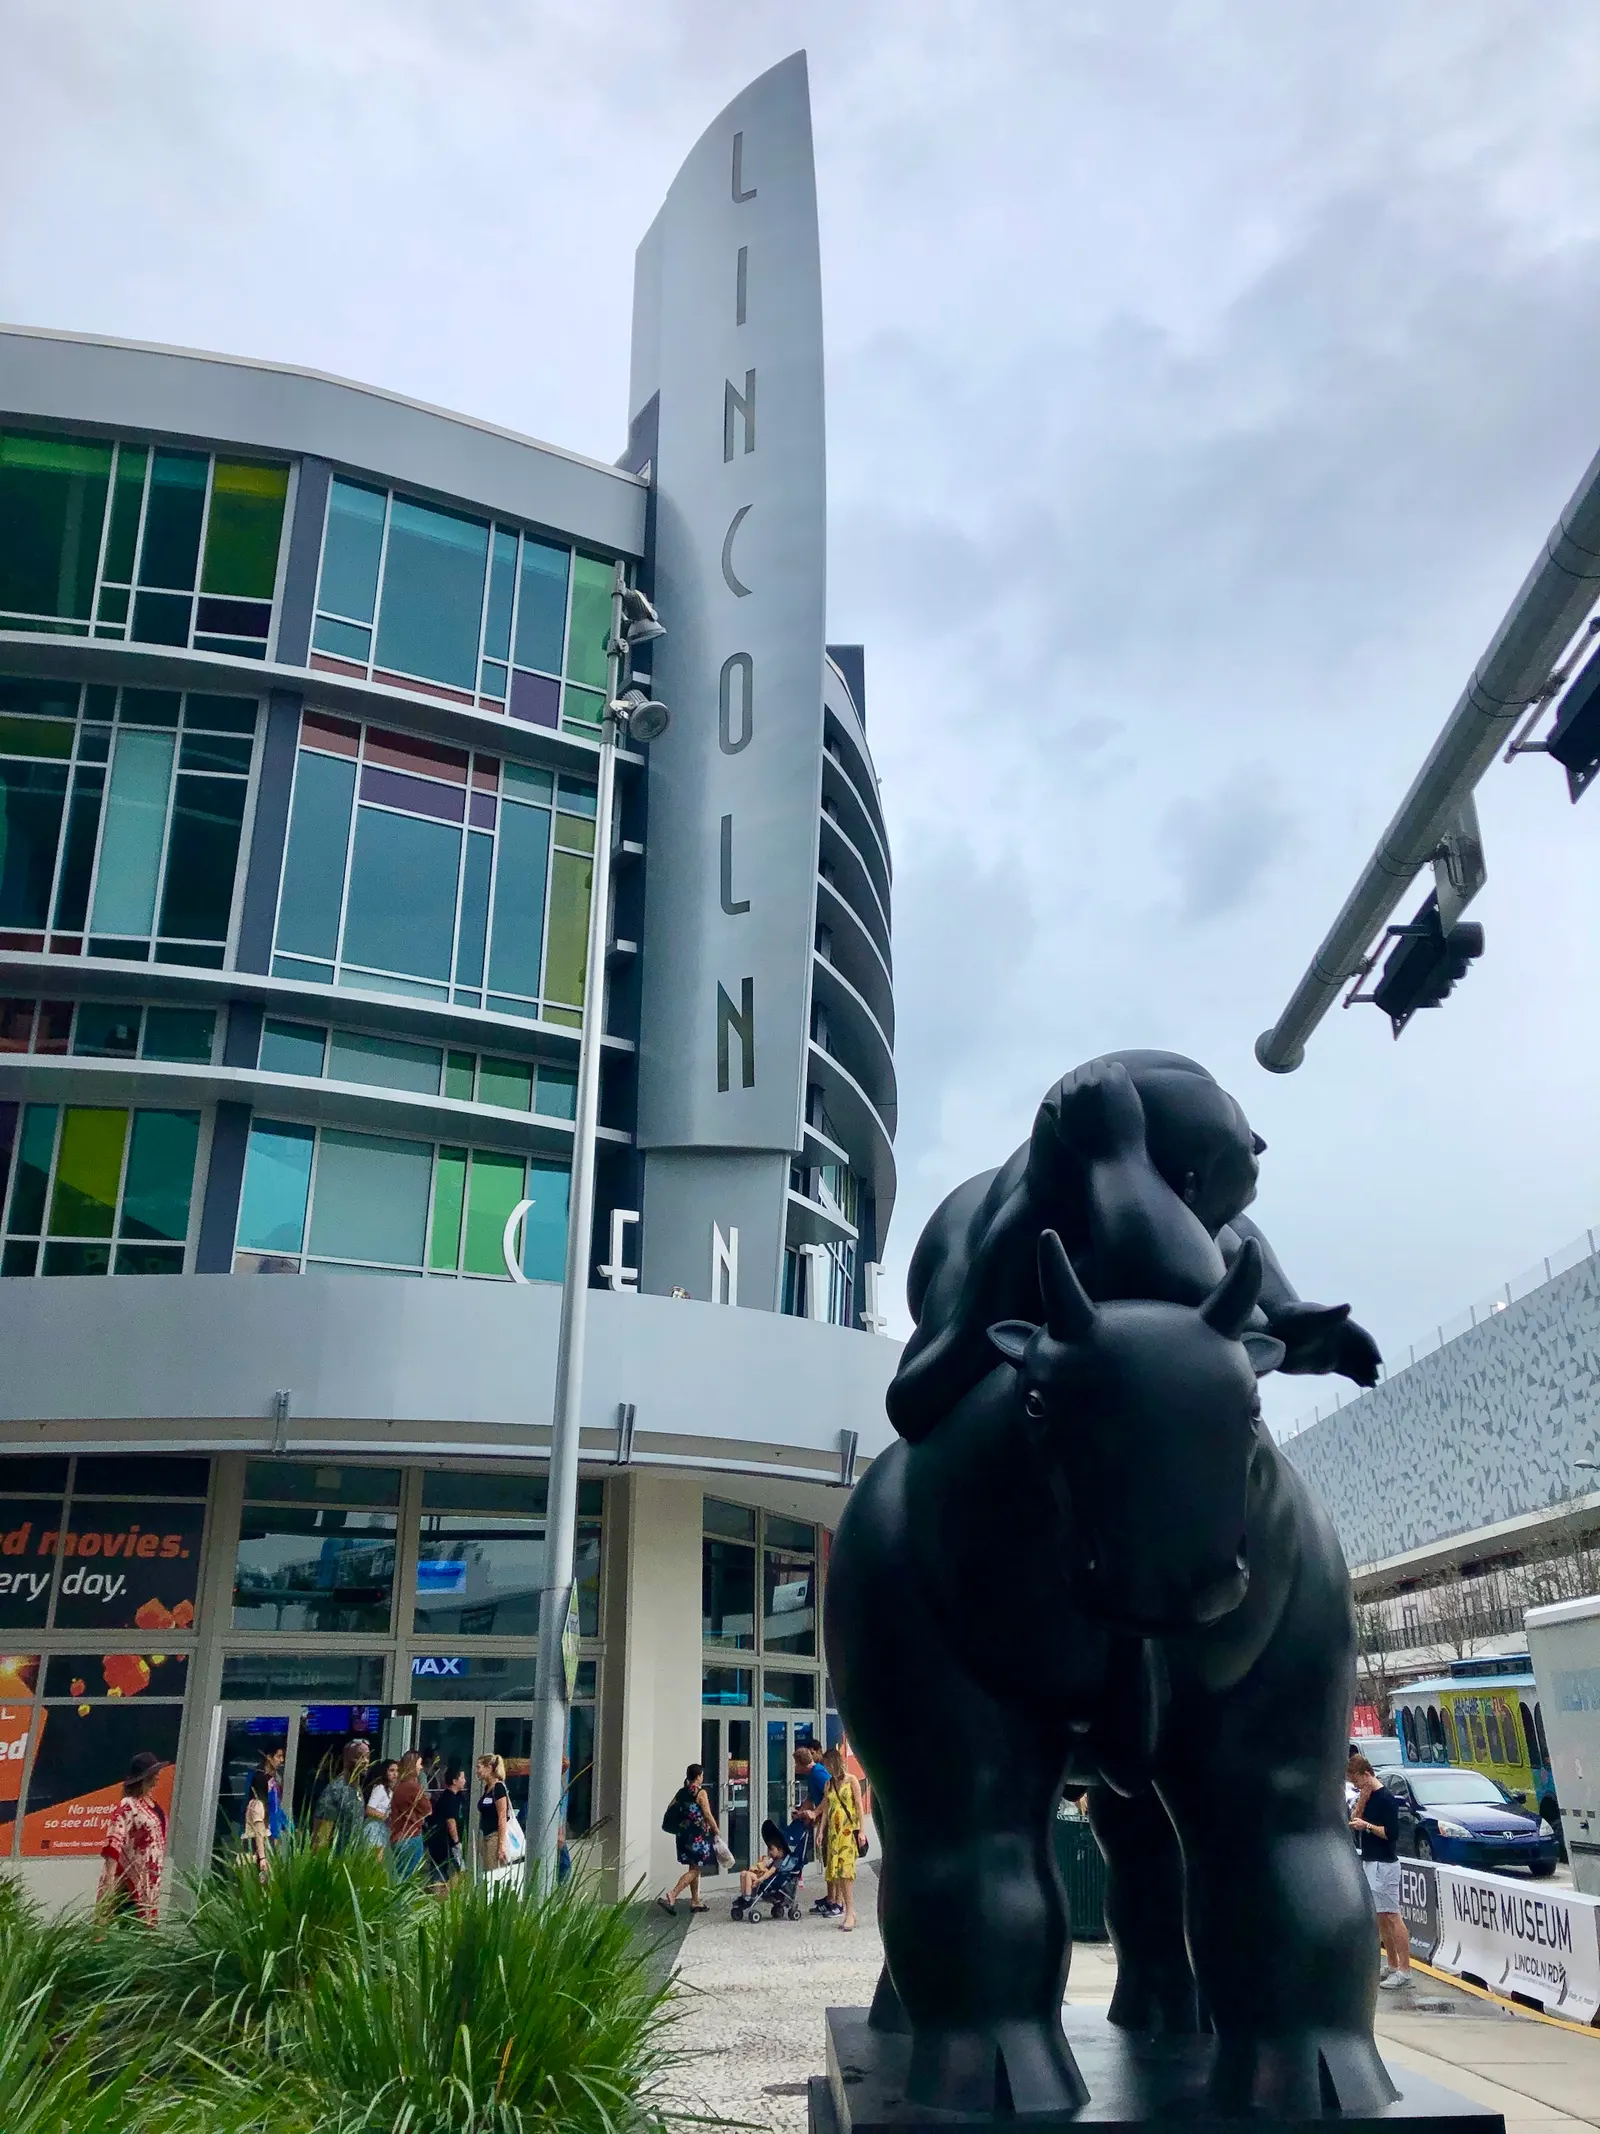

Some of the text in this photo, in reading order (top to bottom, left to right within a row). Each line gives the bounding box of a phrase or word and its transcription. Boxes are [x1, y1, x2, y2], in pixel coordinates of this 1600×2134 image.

[717, 131, 757, 1093] LINCOLN
[0, 1521, 190, 1559] d movies.
[62, 1566, 127, 1603] day.
[44, 1820, 59, 1829] so
[60, 1819, 81, 1828] see
[82, 1816, 99, 1828] all
[68, 1804, 85, 1815] No
[1401, 1869, 1427, 1908] ERO
[1452, 1882, 1499, 1932] NADER
[1500, 1893, 1573, 1954] MUSEUM
[1514, 1952, 1547, 1979] LINCOLN
[1547, 1963, 1559, 1984] RD
